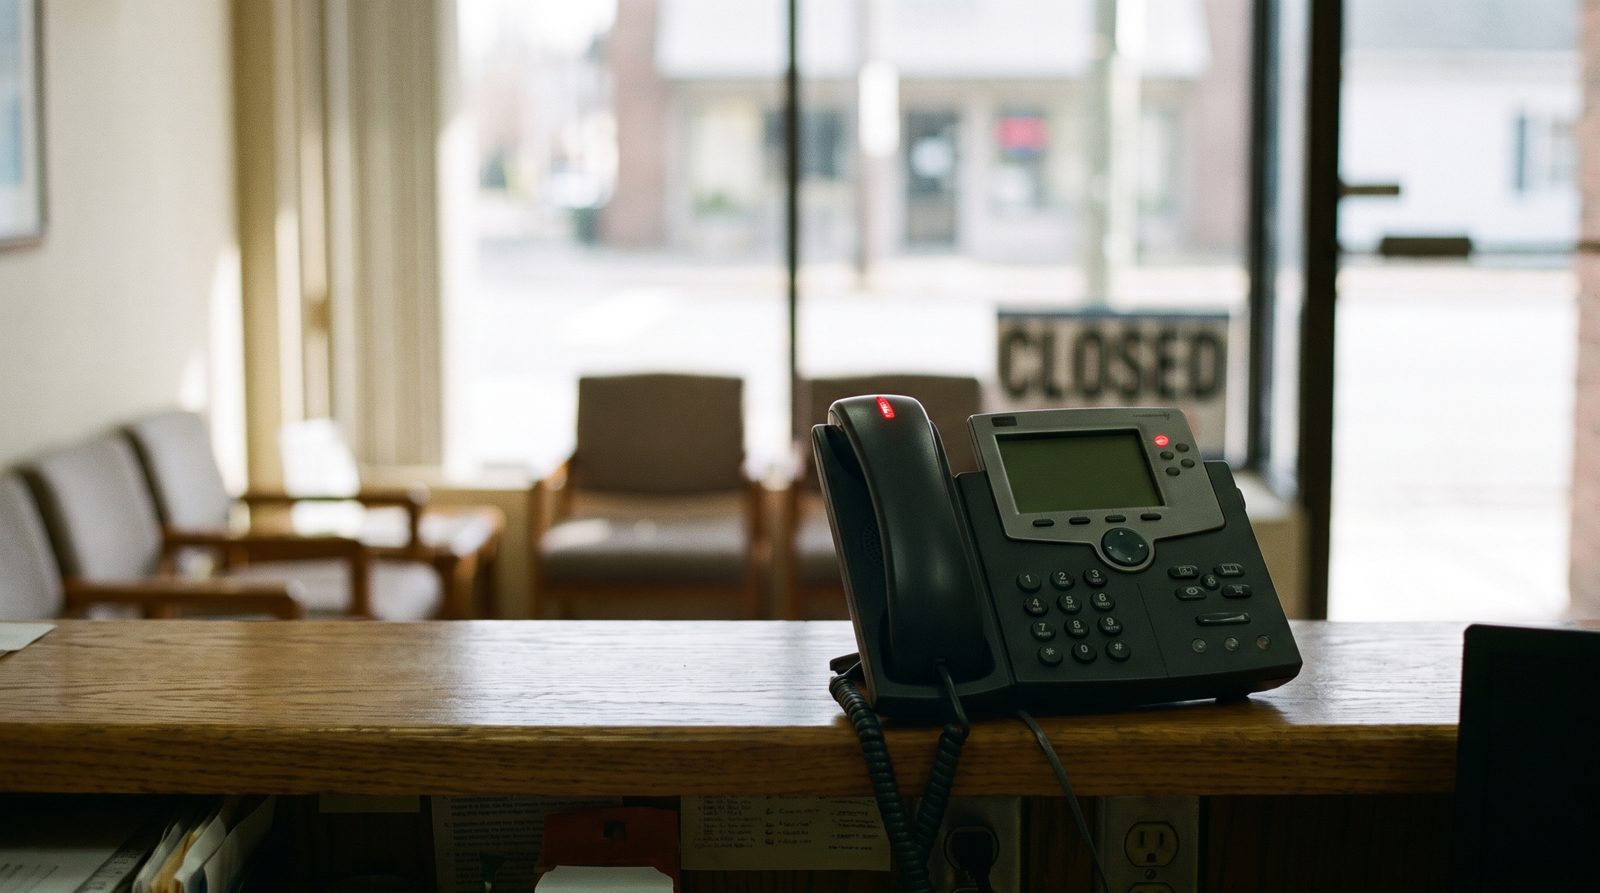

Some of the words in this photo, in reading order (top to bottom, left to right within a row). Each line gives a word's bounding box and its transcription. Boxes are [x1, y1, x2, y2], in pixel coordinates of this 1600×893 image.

[999, 329, 1227, 399] CLOSED
[1059, 572, 1066, 580] 2
[1092, 570, 1100, 578] 3
[1066, 596, 1073, 604] 5
[1098, 593, 1106, 602] 6
[1032, 598, 1040, 606] 4
[1073, 620, 1080, 628] 8
[1106, 618, 1114, 626] 9
[1039, 622, 1046, 632] 7
[1080, 644, 1088, 652] 0
